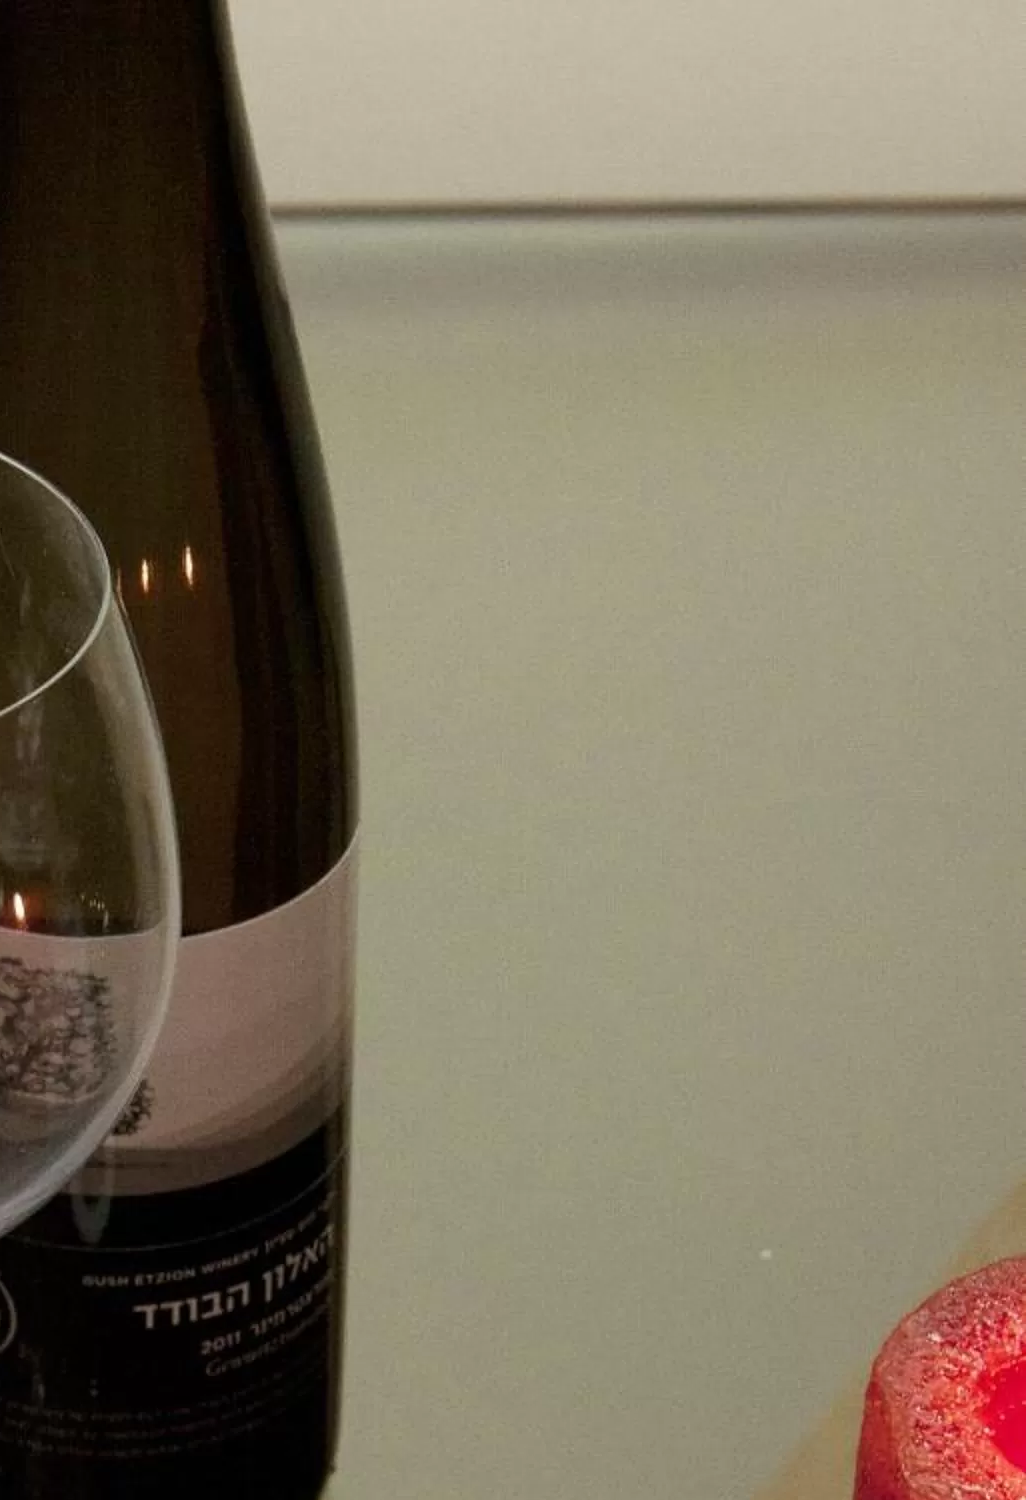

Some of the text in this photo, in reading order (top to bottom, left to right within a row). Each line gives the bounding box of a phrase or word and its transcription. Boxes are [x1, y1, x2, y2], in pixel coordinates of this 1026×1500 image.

[81, 1247, 260, 1288] GUSH ETZION WINERY
[261, 1222, 336, 1304] האלון
[131, 1279, 251, 1330] הבודד
[201, 1330, 242, 1356] 2011
